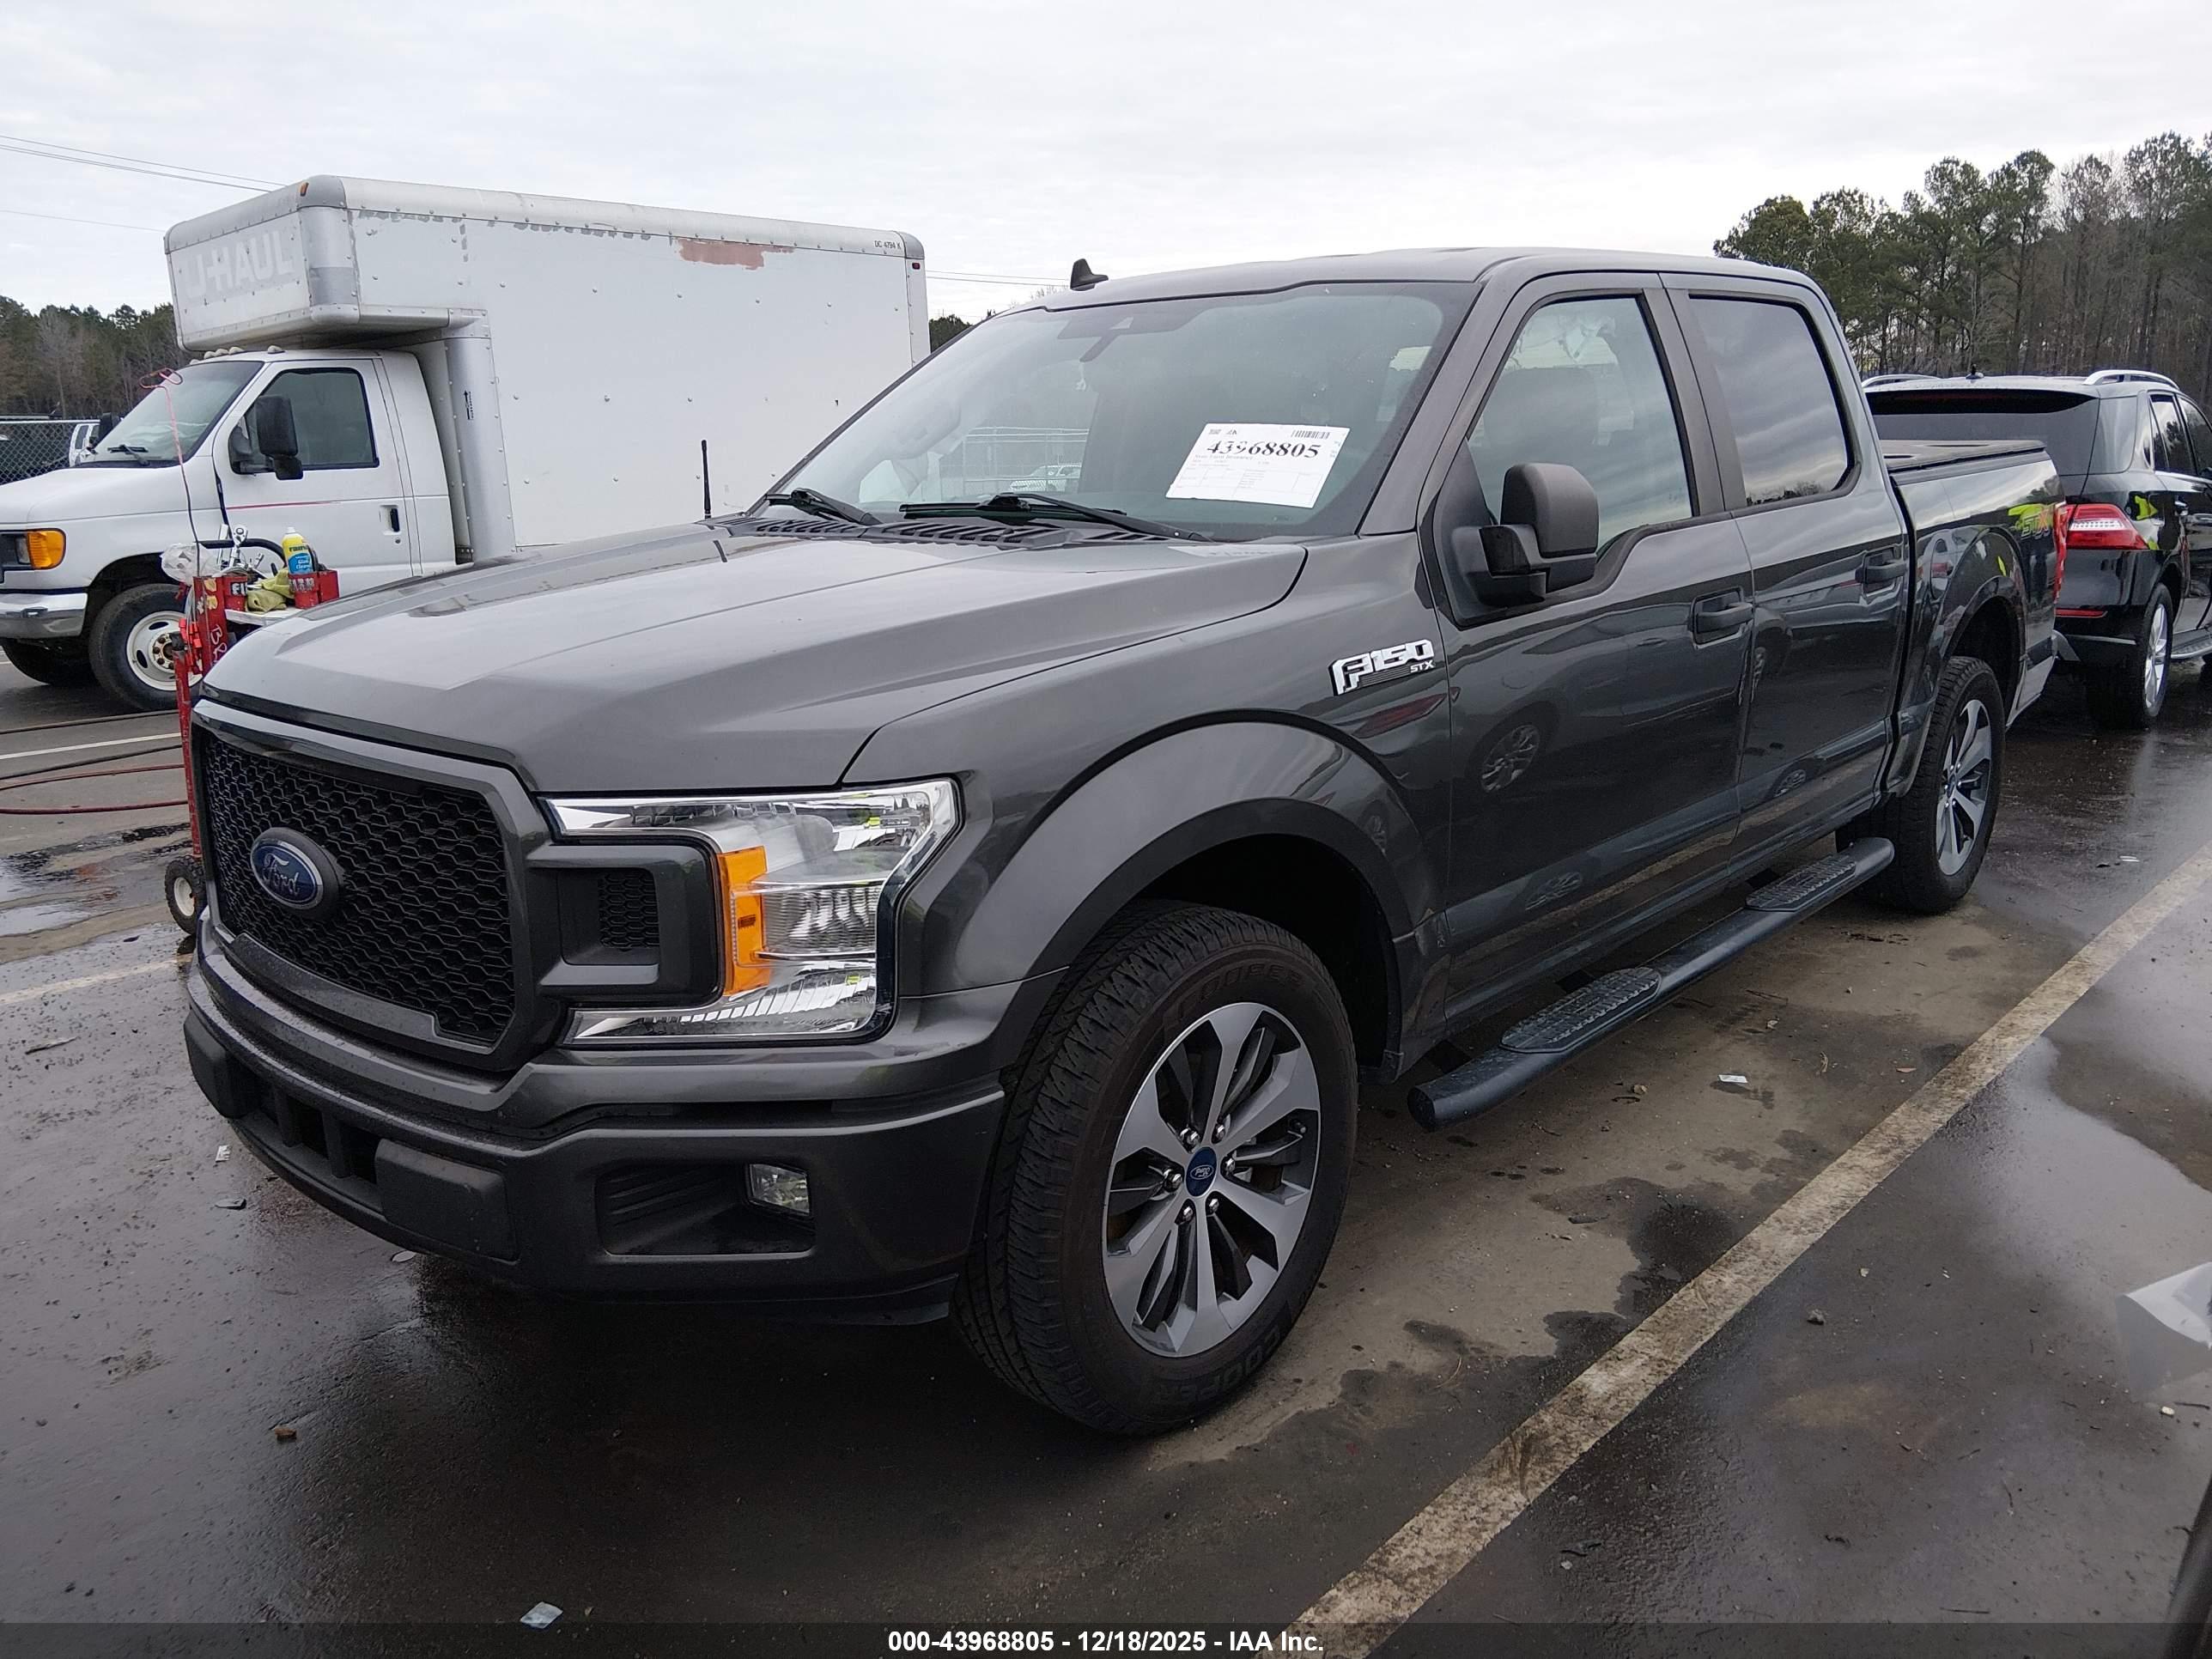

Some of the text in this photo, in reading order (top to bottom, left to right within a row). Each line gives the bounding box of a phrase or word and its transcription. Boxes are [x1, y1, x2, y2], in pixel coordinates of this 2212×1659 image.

[183, 231, 295, 298] U-HAUL
[1206, 440, 1322, 459] 43968805
[1410, 659, 1435, 673] STX
[262, 853, 301, 896] Ford
